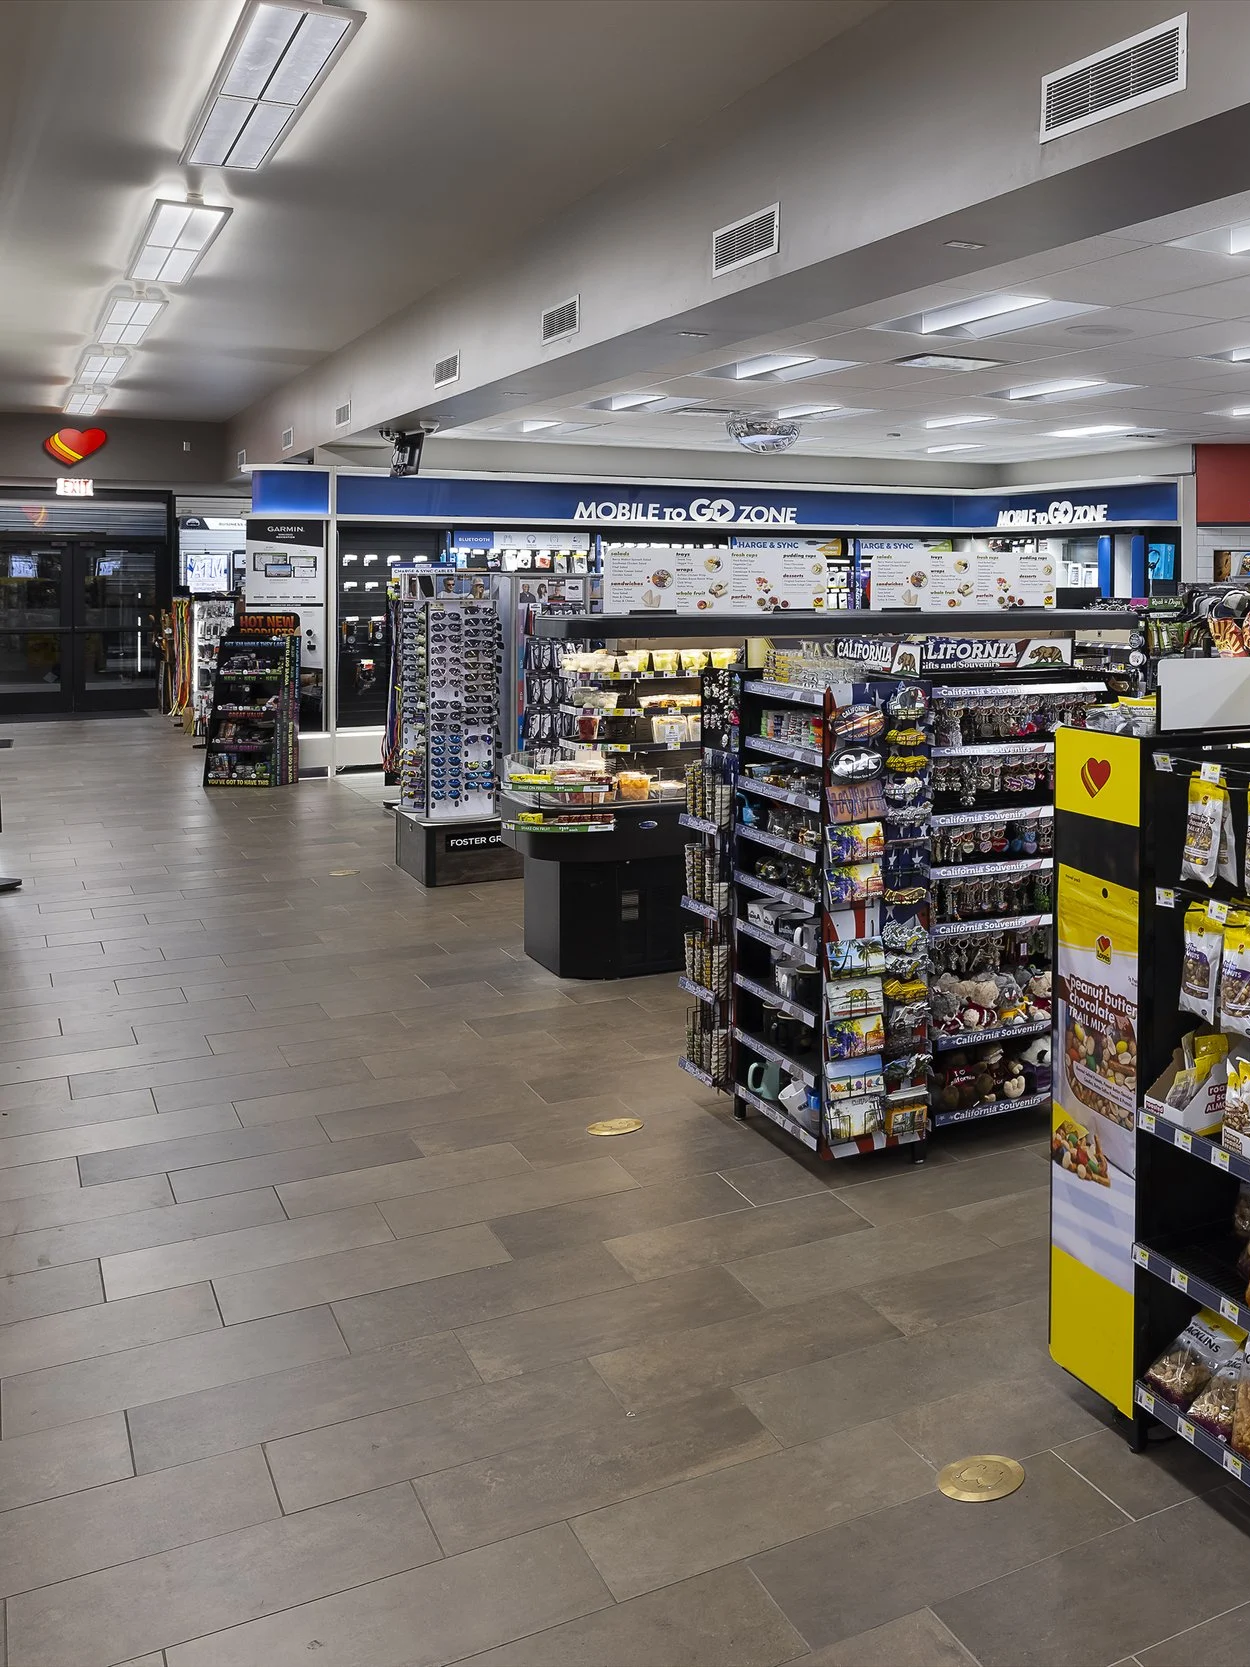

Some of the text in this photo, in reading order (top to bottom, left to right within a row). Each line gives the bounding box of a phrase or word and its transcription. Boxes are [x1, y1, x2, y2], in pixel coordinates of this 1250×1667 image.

[63, 479, 89, 494] EXIT
[574, 501, 660, 521] MOBILE
[689, 499, 735, 523] GO
[738, 506, 797, 525] ZONE
[997, 509, 1036, 527] MOBILE
[1048, 501, 1074, 525] GO
[1073, 504, 1108, 523] ZONE
[738, 541, 768, 549] HARGE
[240, 615, 265, 628] HOT
[267, 615, 295, 628] NEW
[837, 642, 892, 662] CALIFORNIA
[922, 642, 1018, 660] LIFORNIA
[941, 661, 956, 670] and
[958, 660, 1000, 669] Souvenirs
[942, 687, 985, 697] California
[842, 706, 870, 718] CALIFORNIA
[944, 747, 988, 756] California
[939, 811, 1027, 825] California Souvenirs
[450, 835, 501, 847] FOSTER GR
[940, 863, 1027, 876] California Souvenirs
[939, 919, 1027, 934] California Souvenirs
[1069, 974, 1138, 1020] peanut butter
[1069, 993, 1115, 1024] chocolate
[1068, 1005, 1107, 1035] TRAIL MIX
[956, 1025, 1043, 1045] California Souvenirs
[953, 1097, 1041, 1120] California Souvenirs
